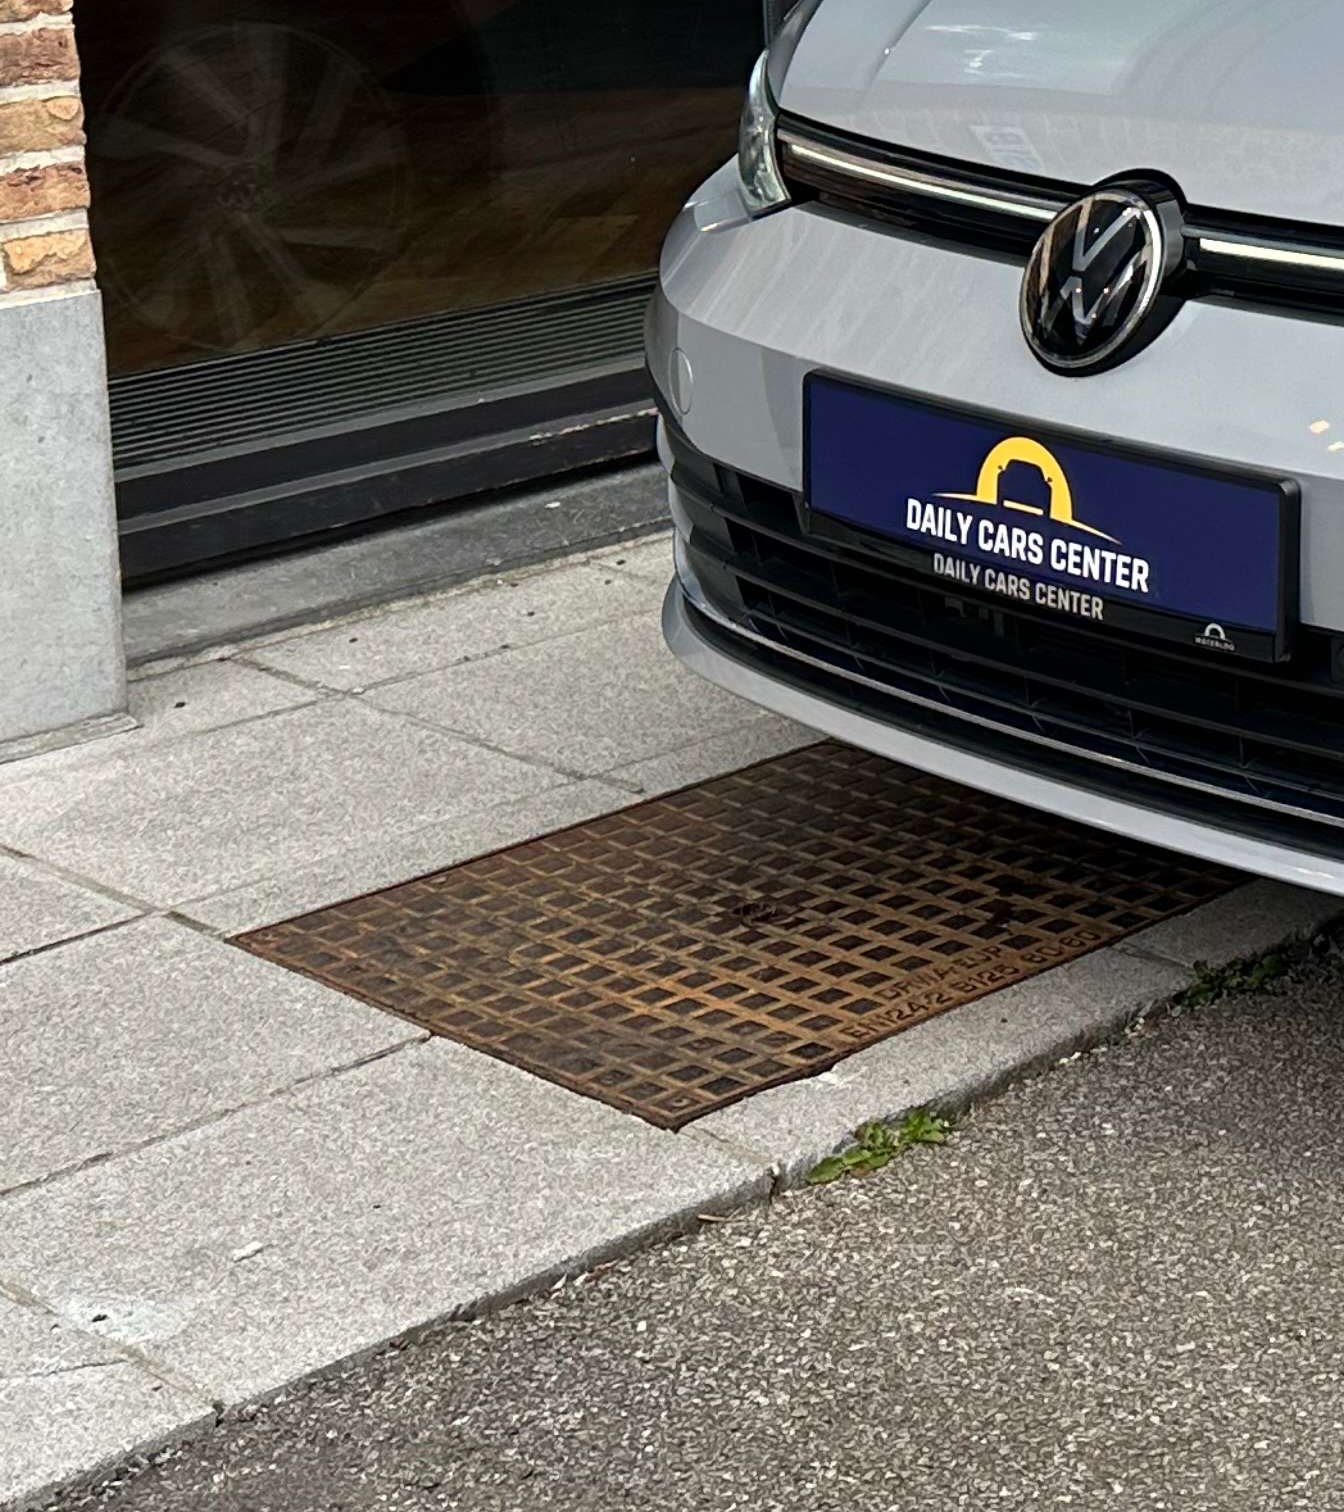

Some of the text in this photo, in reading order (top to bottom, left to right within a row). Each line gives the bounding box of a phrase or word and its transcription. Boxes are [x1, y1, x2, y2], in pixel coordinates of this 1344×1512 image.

[906, 498, 1150, 593] DAILY CARS CENTER
[933, 552, 1104, 621] DAILY CARS CENTER
